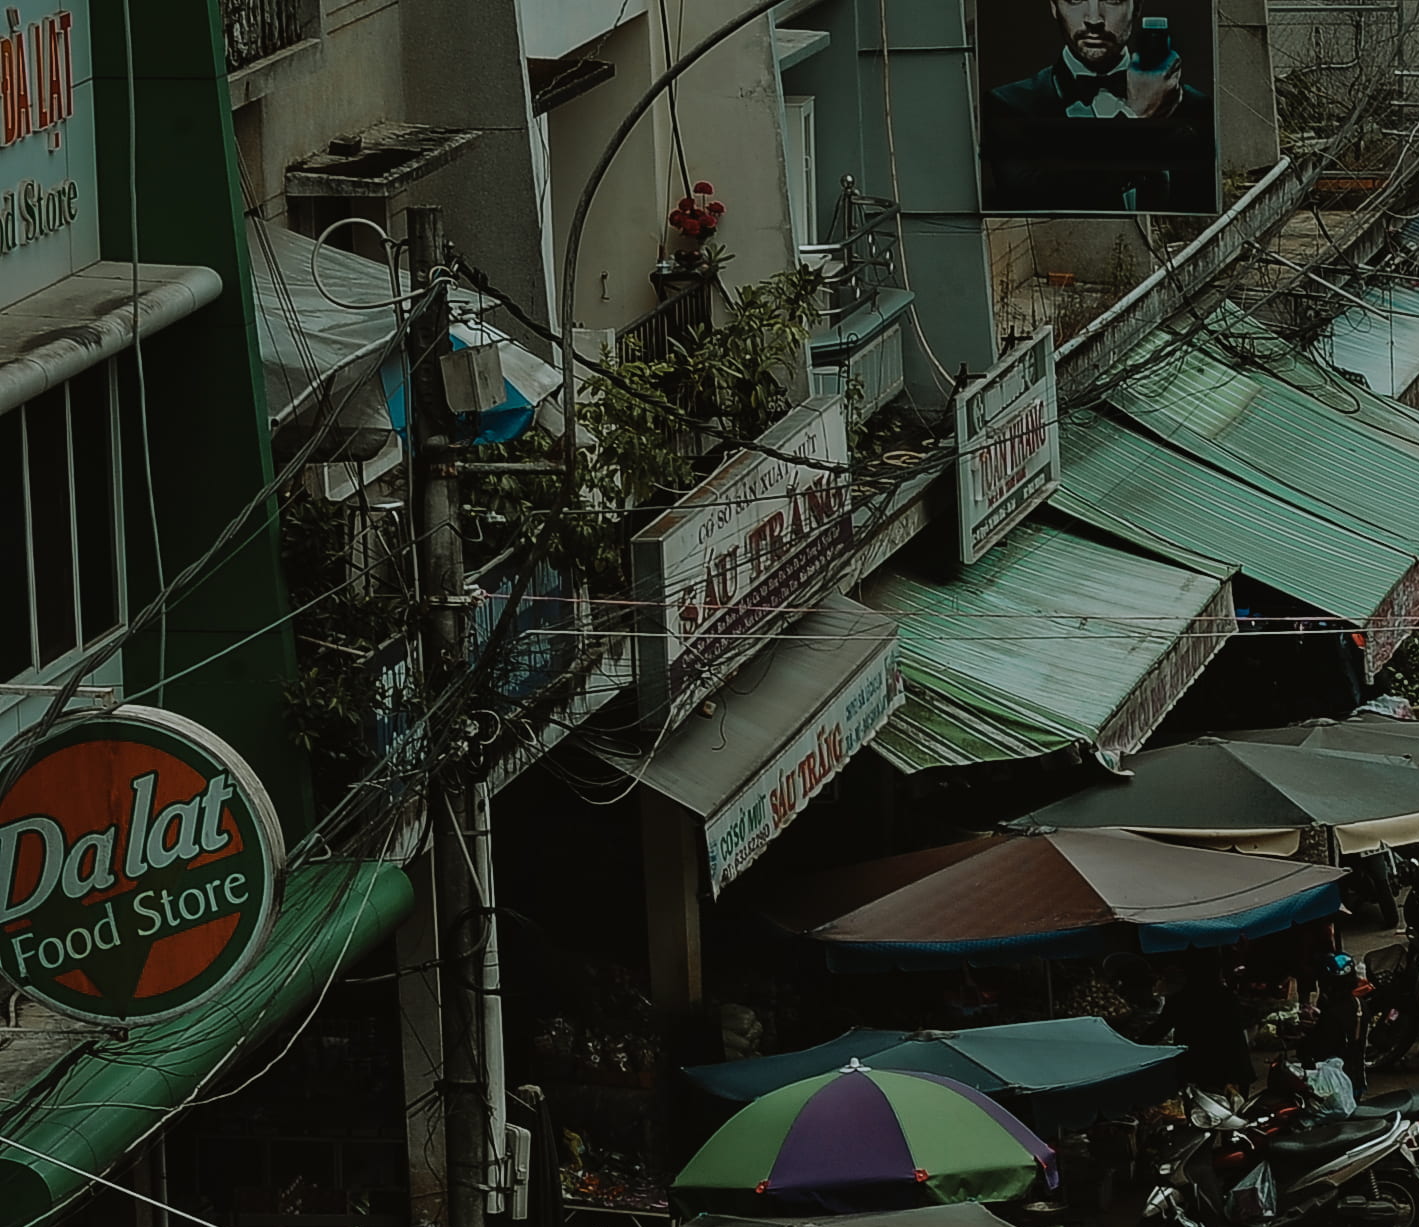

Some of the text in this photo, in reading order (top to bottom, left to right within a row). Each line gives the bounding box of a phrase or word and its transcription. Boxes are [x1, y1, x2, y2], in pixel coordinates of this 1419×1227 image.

[28, 11, 73, 152] LẠT
[20, 178, 79, 247] Store
[769, 767, 798, 830] SÁU
[797, 721, 846, 800] TRẮNG
[0, 771, 234, 925] Dalat
[11, 872, 250, 978] Food Store
